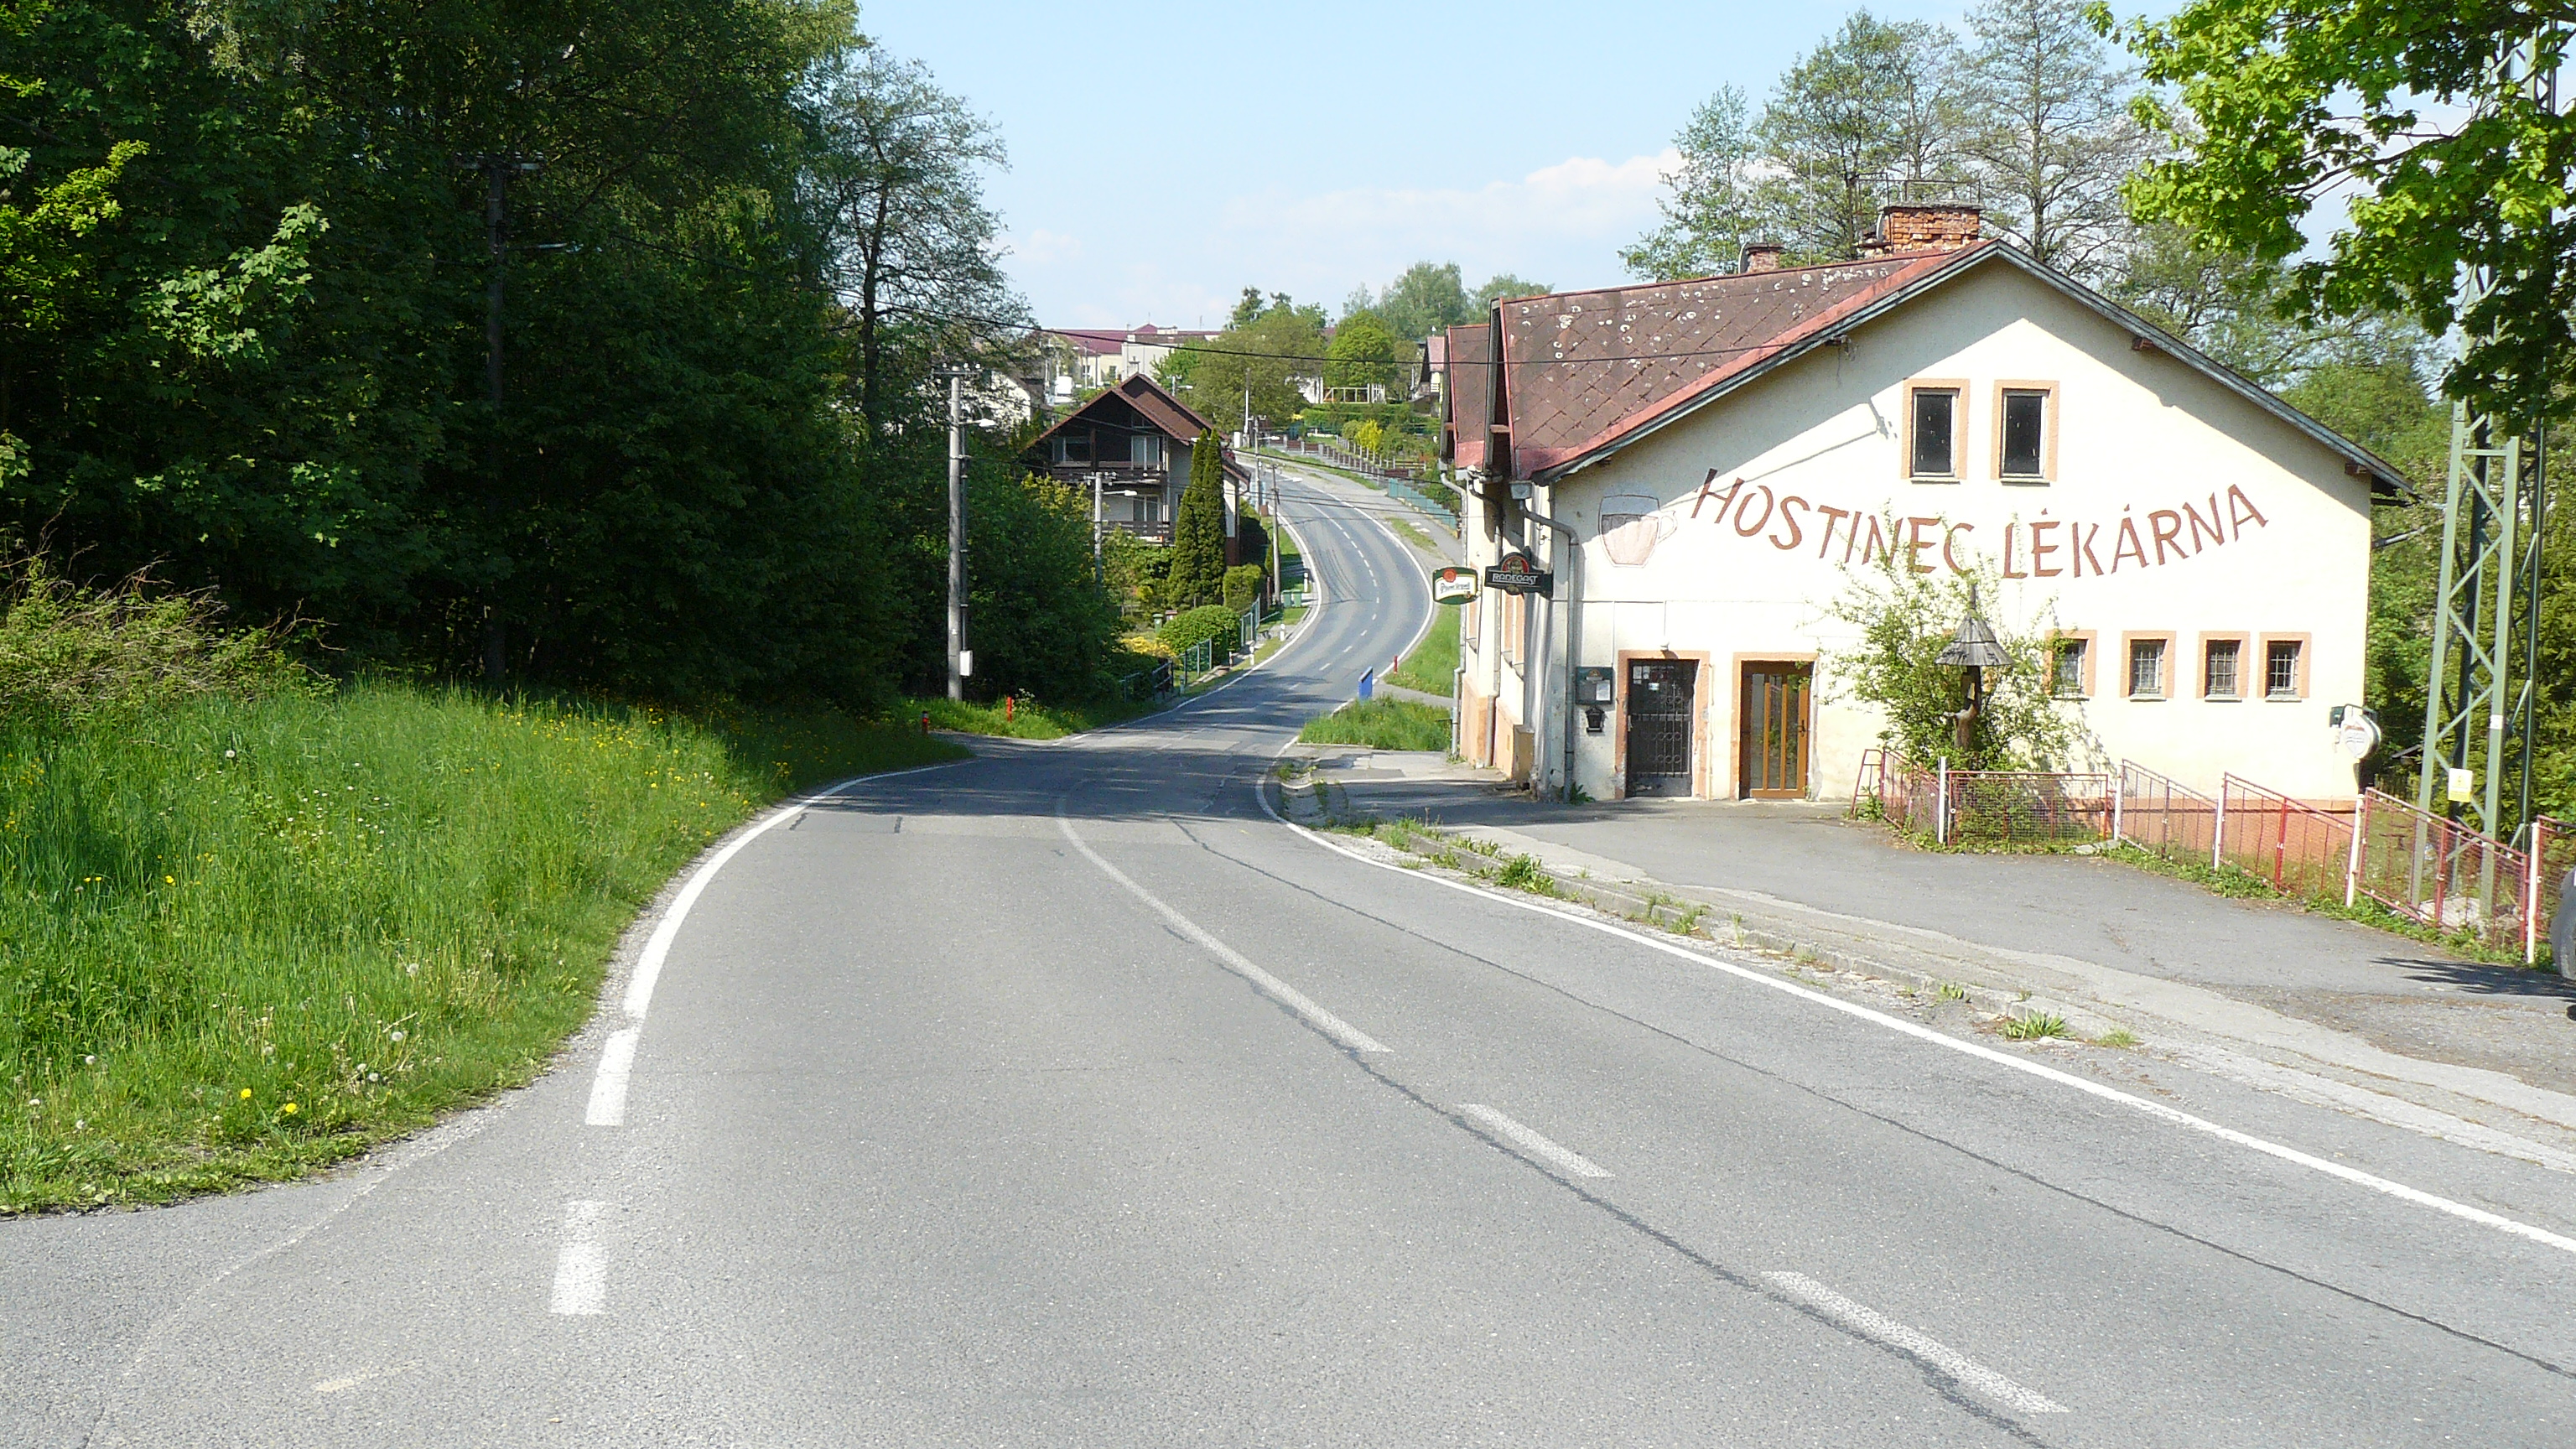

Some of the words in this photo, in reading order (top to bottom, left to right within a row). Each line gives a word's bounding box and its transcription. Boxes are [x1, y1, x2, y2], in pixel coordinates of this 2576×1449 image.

[1690, 468, 1975, 575] HOSTINEC
[2002, 483, 2269, 579] LÉKÁRNA
[1492, 573, 1539, 585] RADEGAST
